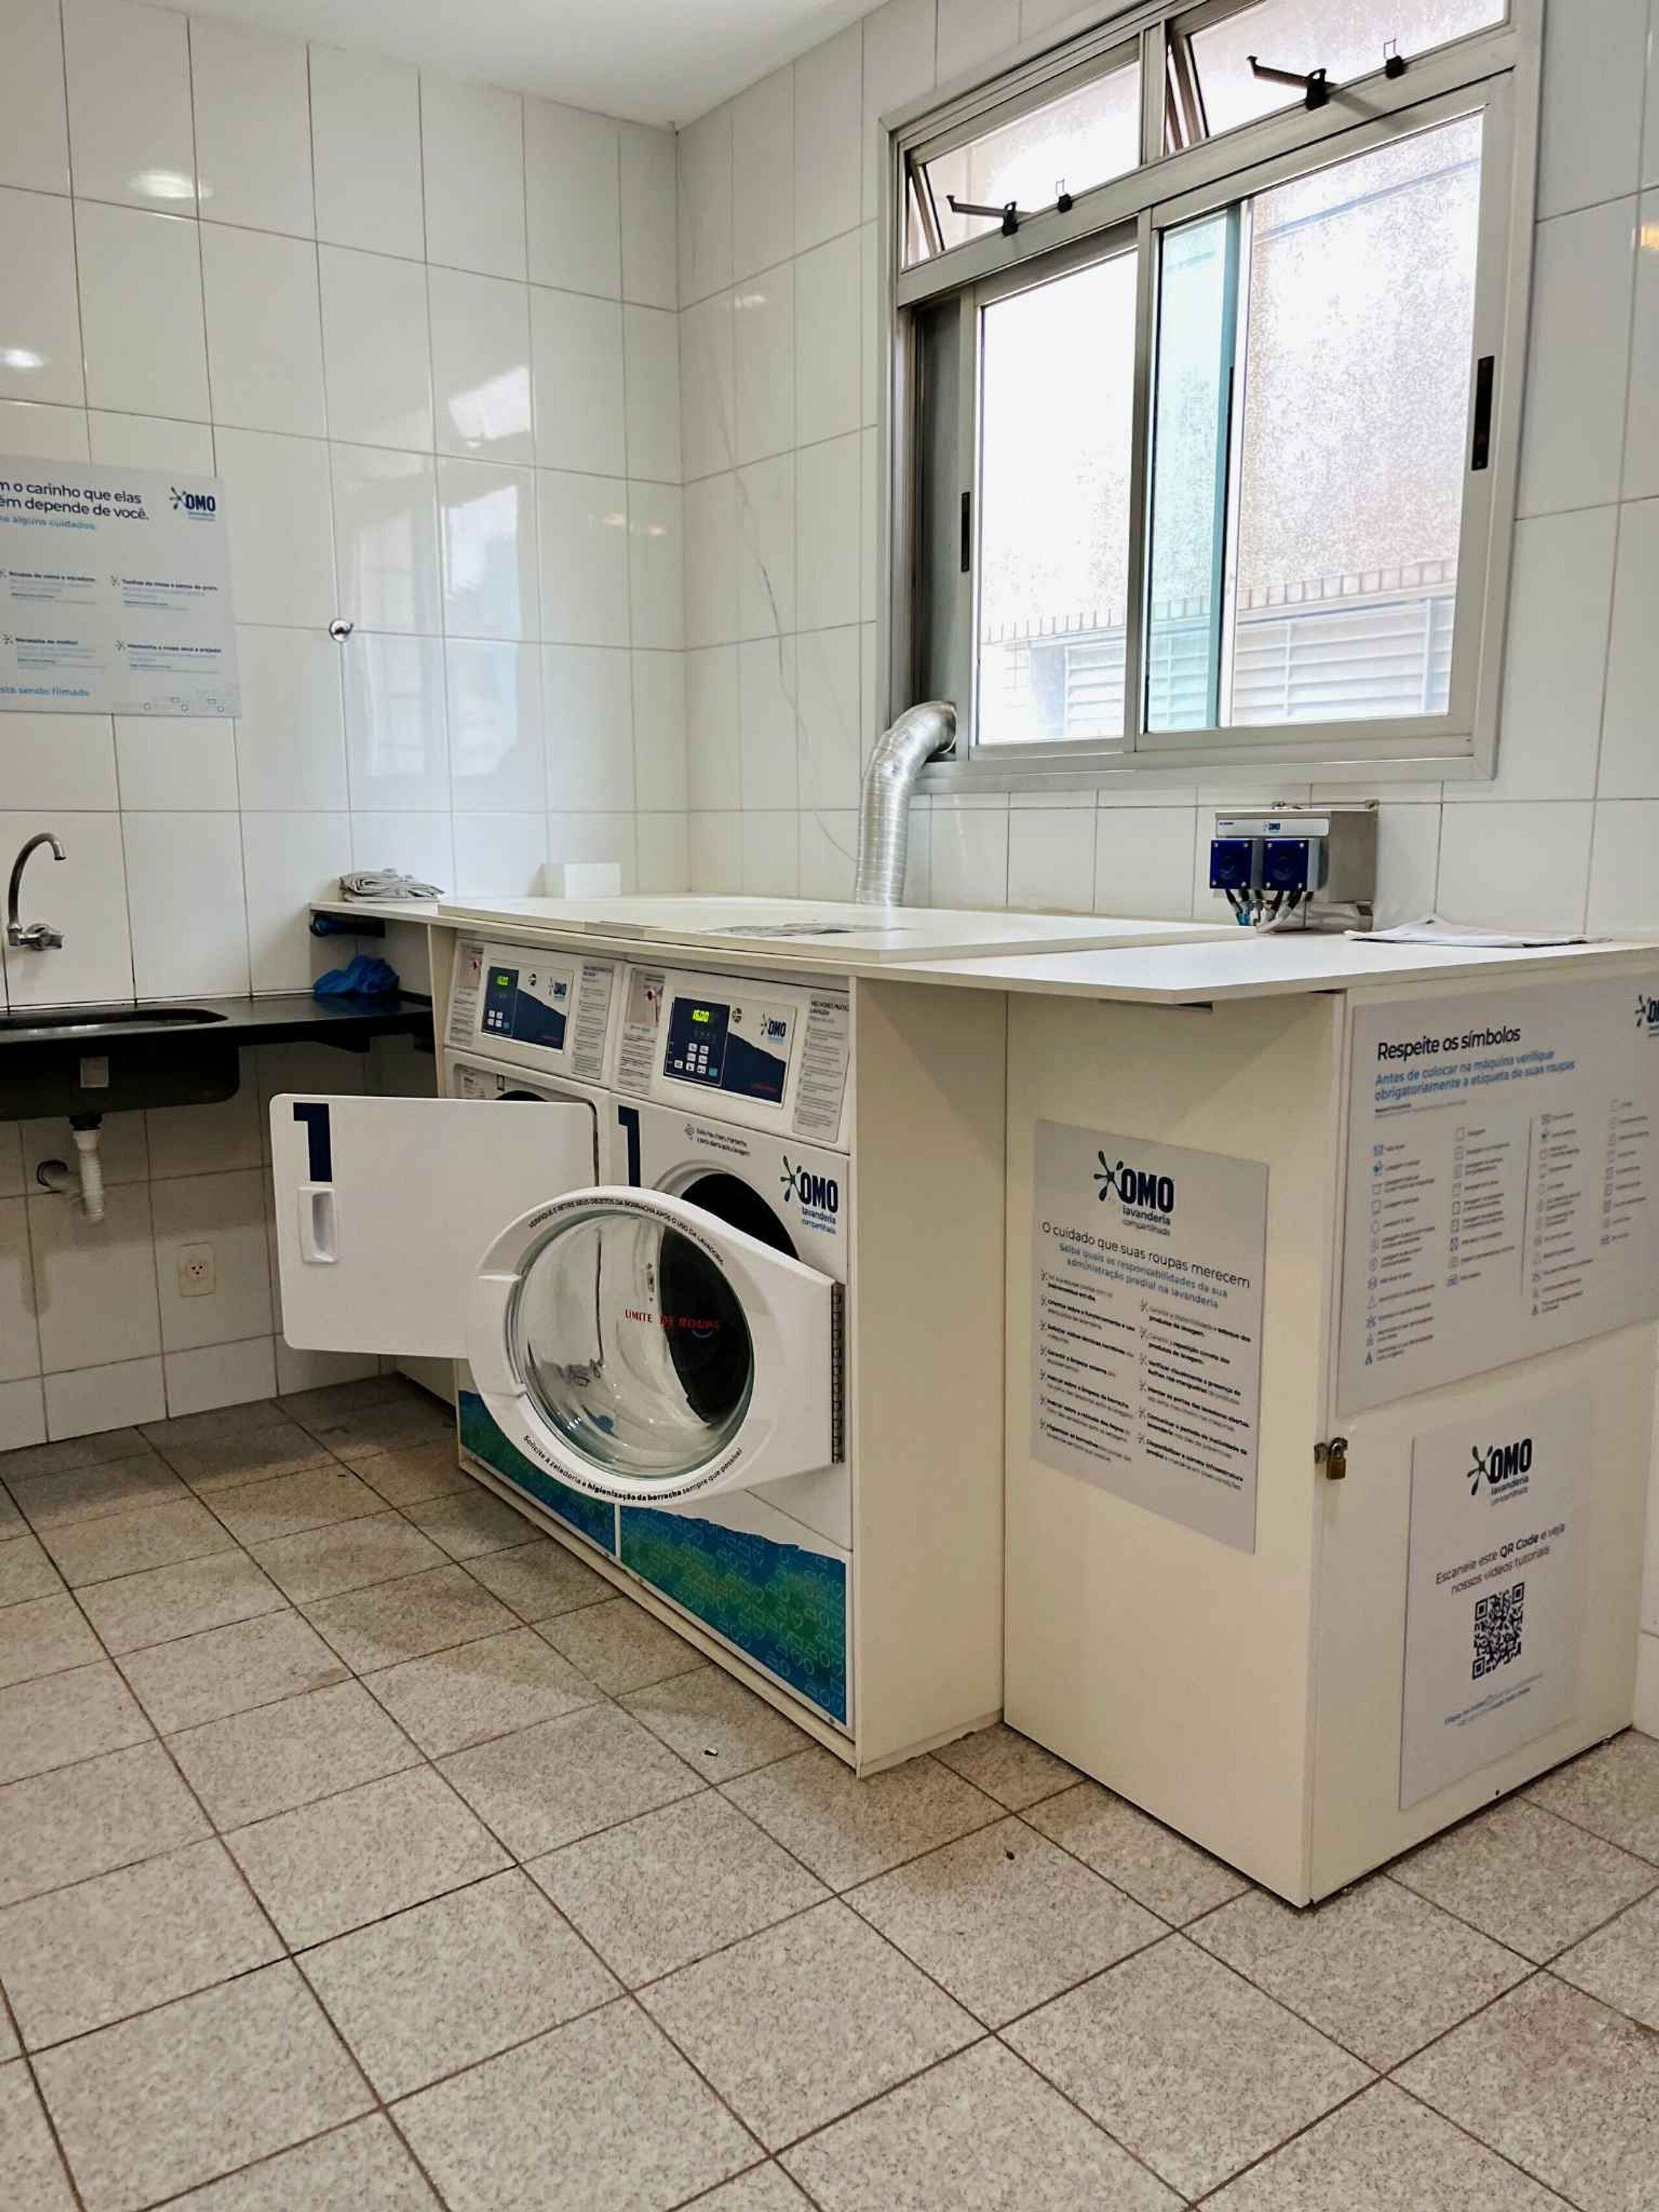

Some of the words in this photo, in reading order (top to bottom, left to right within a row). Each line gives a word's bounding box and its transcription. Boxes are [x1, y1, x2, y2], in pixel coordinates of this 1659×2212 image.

[14, 483, 23, 493] o
[27, 482, 81, 498] carinho
[84, 489, 111, 502] que
[114, 491, 142, 504] elas
[25, 498, 89, 514] depende
[93, 504, 111, 517] de
[113, 507, 150, 520] você.
[185, 493, 216, 512] OMO
[767, 1020, 787, 1038] OMO
[1378, 1035, 1440, 1062] Respeite
[1443, 1037, 1459, 1051] os
[1460, 1025, 1521, 1049] símbolos
[1375, 1071, 1405, 1087] Antes
[1406, 1069, 1420, 1082] de
[1422, 1064, 1458, 1078] colocar
[1459, 1062, 1472, 1073] na
[1473, 1055, 1514, 1071] máquina
[1375, 1077, 1461, 1101] obrigatoriamente
[1470, 1071, 1509, 1087] etiqueta
[800, 1172, 839, 1213] OMO
[1118, 1169, 1174, 1214] OMO
[1123, 1205, 1171, 1226] lavanderia
[1042, 1222, 1052, 1233] O
[1053, 1226, 1095, 1245] cuidado
[1097, 1237, 1119, 1252] que
[1120, 1244, 1146, 1259] suas
[1148, 1252, 1189, 1272] roupas
[1190, 1263, 1250, 1288] merecem
[1067, 1257, 1125, 1281] administração
[1125, 1274, 1156, 1290] predial
[1157, 1284, 1169, 1294] na
[1170, 1286, 1219, 1309] lavanderia
[1117, 1259, 1196, 1289] responsabilidades
[1211, 1286, 1228, 1298] sua
[625, 1308, 653, 1323] LIMITE
[660, 1314, 675, 1327] DE
[524, 1434, 546, 1460] Solicite
[550, 1461, 581, 1485] zeladoria
[587, 1482, 636, 1501] higienização
[648, 1490, 682, 1501] borracha
[682, 1479, 708, 1495] sempre
[708, 1470, 721, 1482] que
[1489, 1438, 1533, 1484] OMO
[1435, 1559, 1476, 1585] Escaneie
[1478, 1551, 1498, 1566] este
[1500, 1542, 1514, 1559] QR
[1516, 1533, 1540, 1551] Code
[1451, 1574, 1483, 1595] nossos
